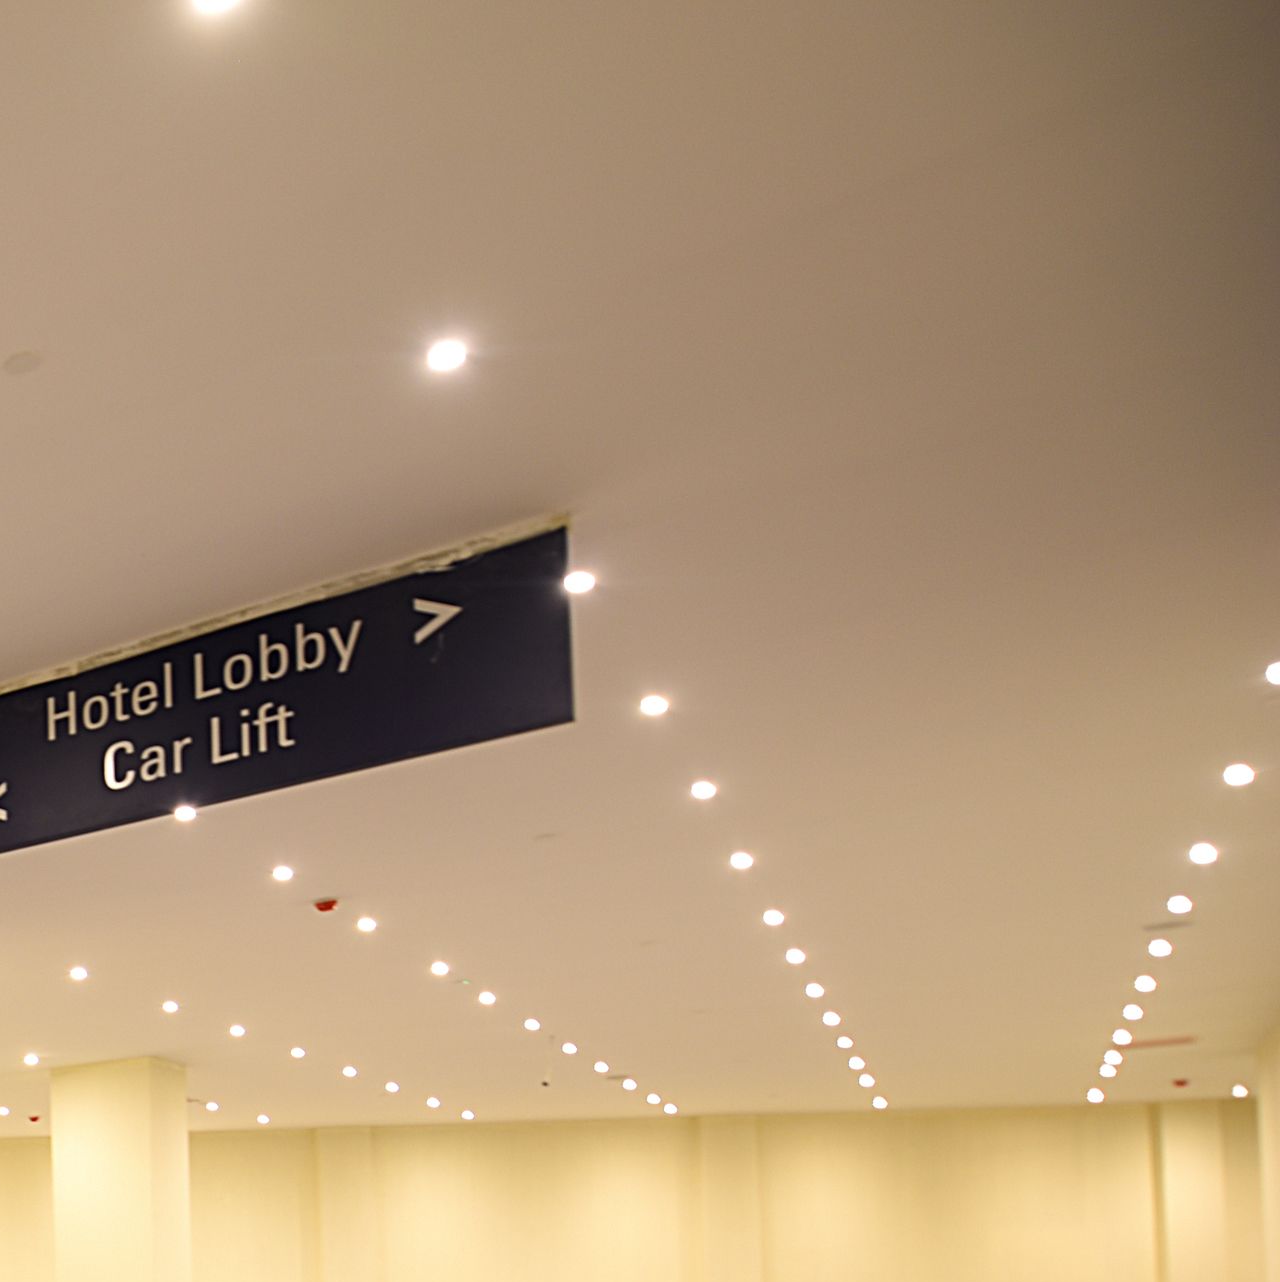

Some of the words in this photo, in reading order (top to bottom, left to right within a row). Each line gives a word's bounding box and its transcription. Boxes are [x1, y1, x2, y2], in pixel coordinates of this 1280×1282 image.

[46, 662, 175, 741] Hotel
[193, 619, 362, 702] Lobby
[102, 734, 192, 791] Car
[210, 702, 296, 765] Lift
